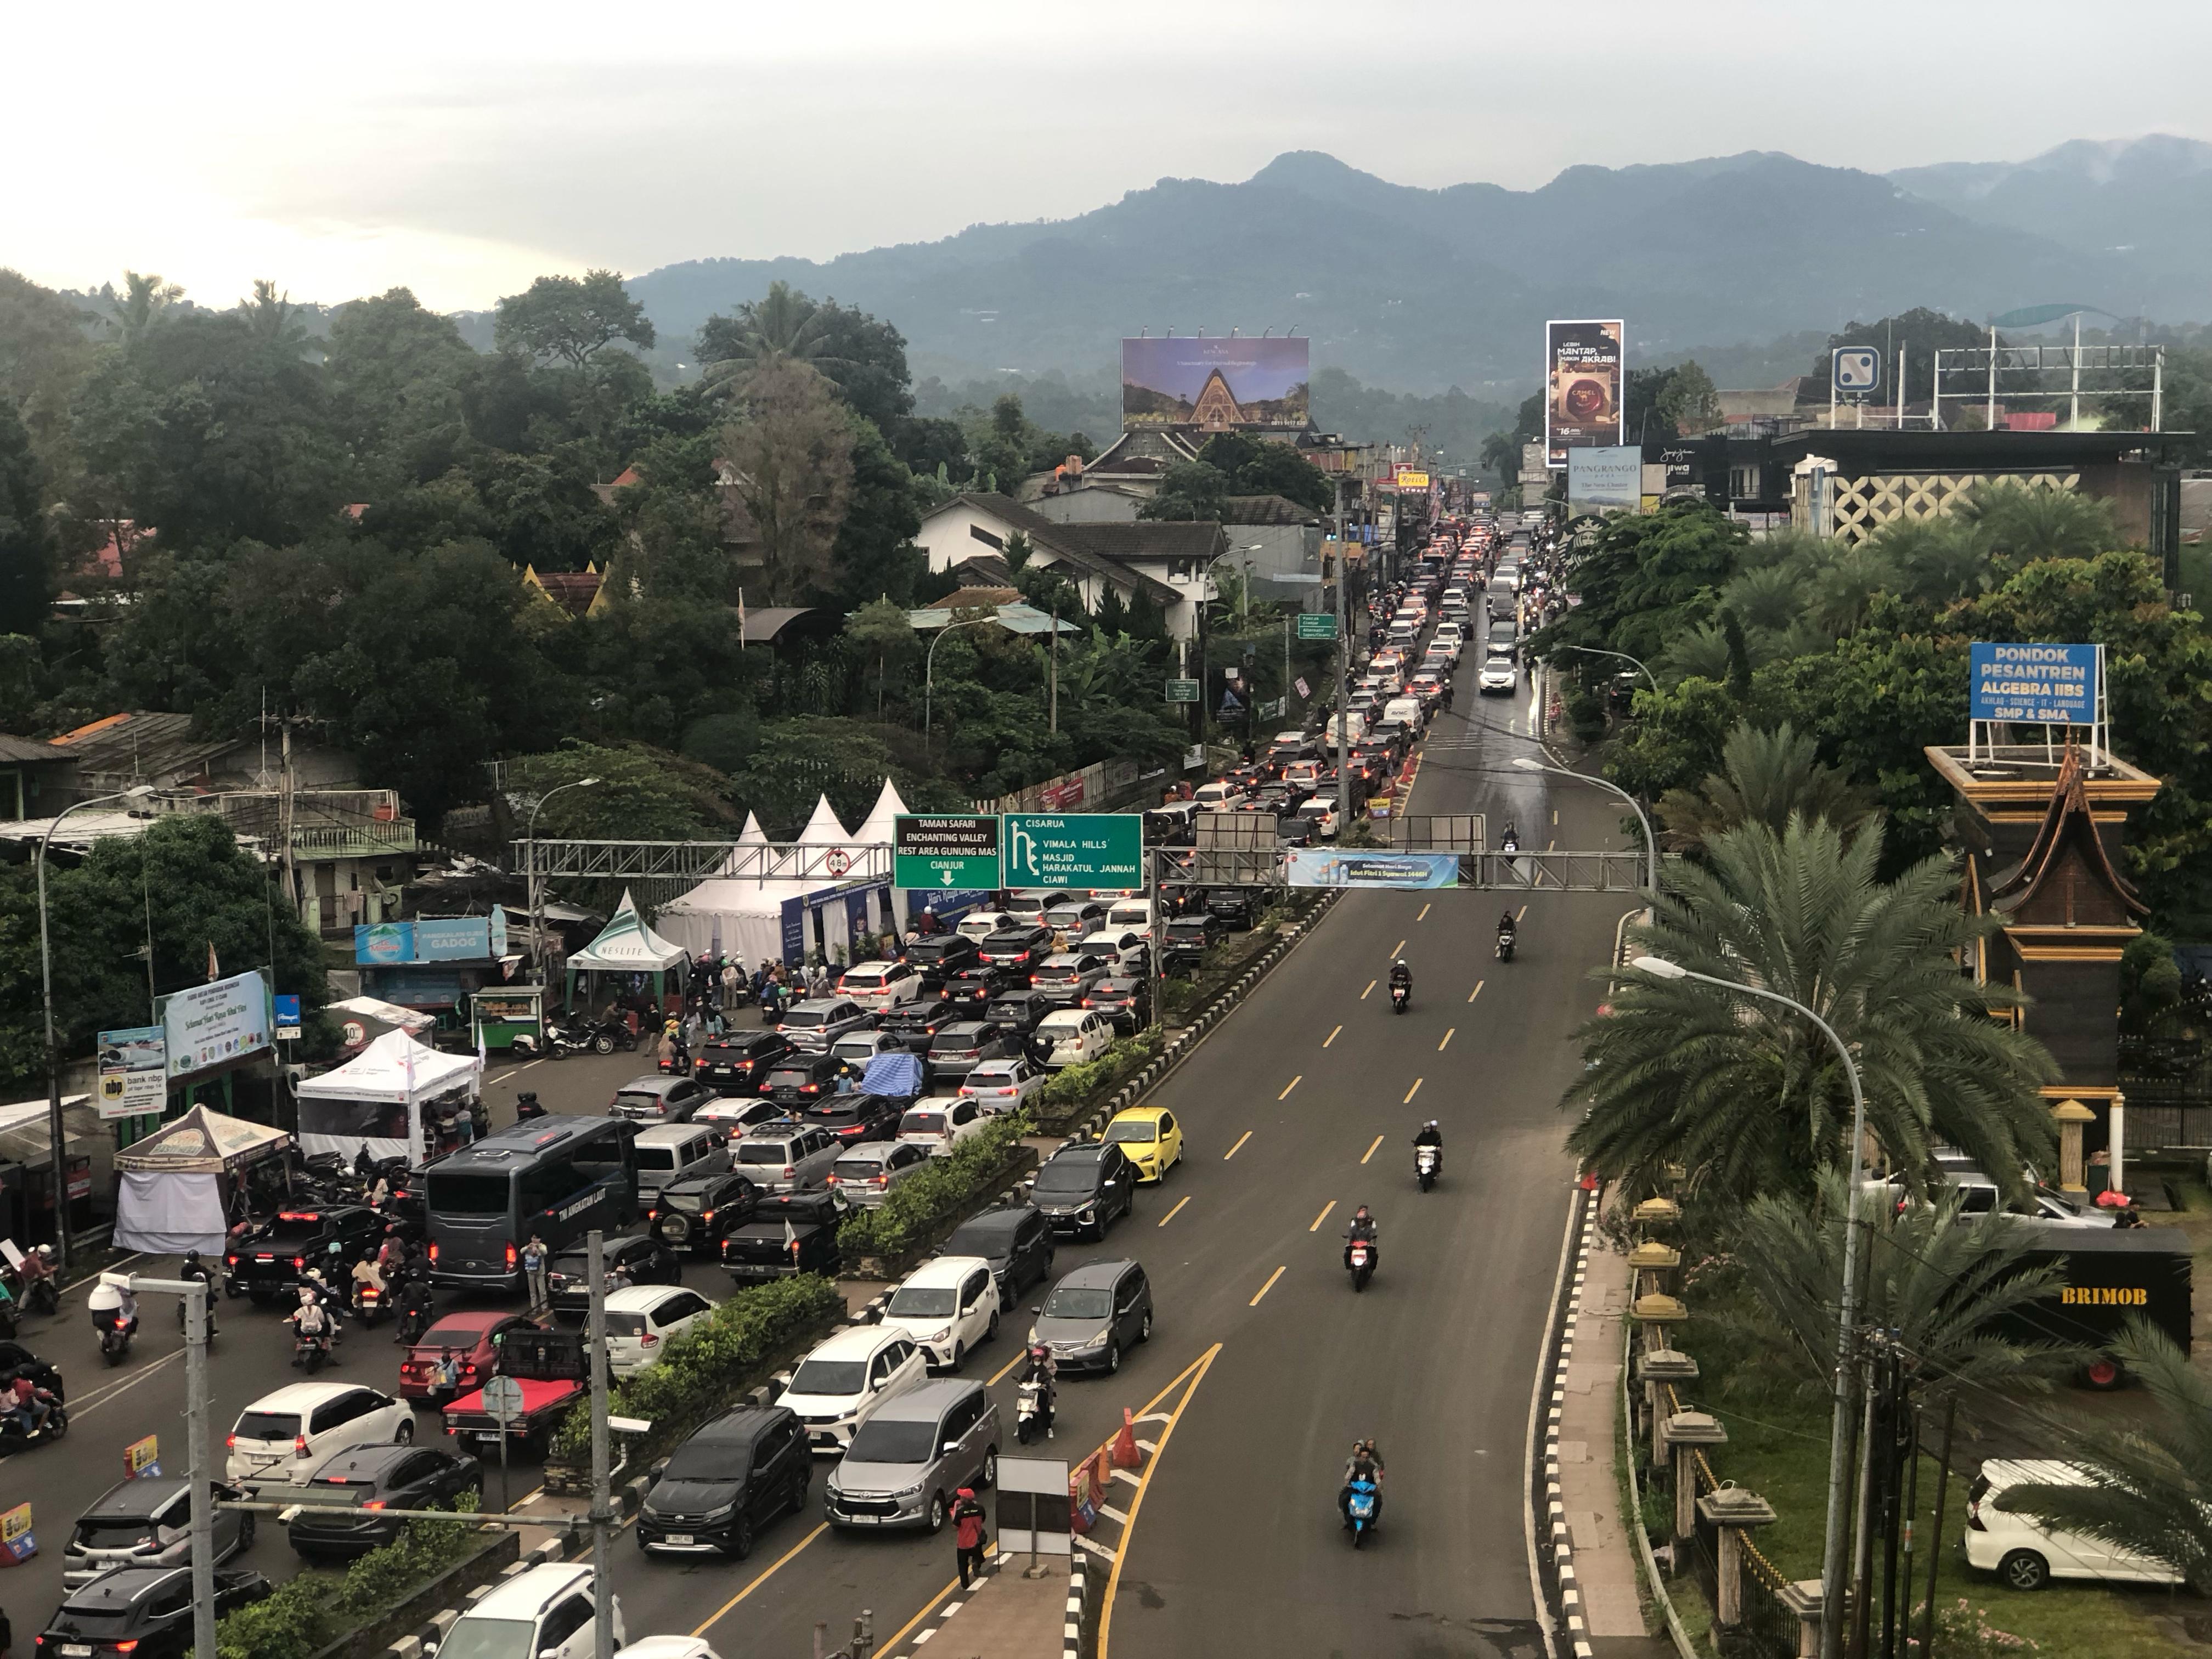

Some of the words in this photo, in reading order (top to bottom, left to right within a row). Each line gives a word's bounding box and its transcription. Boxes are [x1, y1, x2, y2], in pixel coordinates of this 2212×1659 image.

[1995, 647, 2069, 663] PONDOK
[1981, 664, 2085, 680] PESANTREN
[1980, 681, 2051, 695] ALGEBRA
[2055, 684, 2085, 697] IIBS
[2010, 697, 2035, 707] SCIENCE
[2041, 698, 2047, 707] IT
[2053, 699, 2085, 709] LANGUAGE
[1995, 707, 2023, 719] SMP
[2026, 709, 2035, 719] &
[2038, 708, 2069, 720] SMA
[918, 819, 947, 828] TAMAN
[949, 819, 976, 828] SAFARI
[1025, 819, 1065, 828] CISARUA
[906, 833, 957, 842] ENCHANTING
[958, 834, 987, 843] VALLEY
[1043, 839, 1077, 849] VIMALA
[1082, 840, 1107, 849] HILLS
[898, 847, 917, 855] REST
[918, 847, 939, 856] AREA
[940, 847, 977, 856] GUNUNG
[978, 847, 996, 856] MAS
[1043, 854, 1075, 862] MASJID
[930, 860, 964, 870] CIANJUR
[1043, 864, 1094, 873] HARAKATUL
[1099, 864, 1135, 873] JANNAH
[1043, 876, 1068, 884] CIAWI
[431, 938, 476, 949] GADOG
[601, 946, 644, 956] NESLITE
[127, 1075, 146, 1085] bank
[148, 1074, 162, 1082] nbp
[105, 1079, 123, 1096] nbp
[568, 1194, 594, 1218] ANGKATAN
[594, 1188, 606, 1204] LAUT
[2062, 1288, 2147, 1305] BRIMOB
